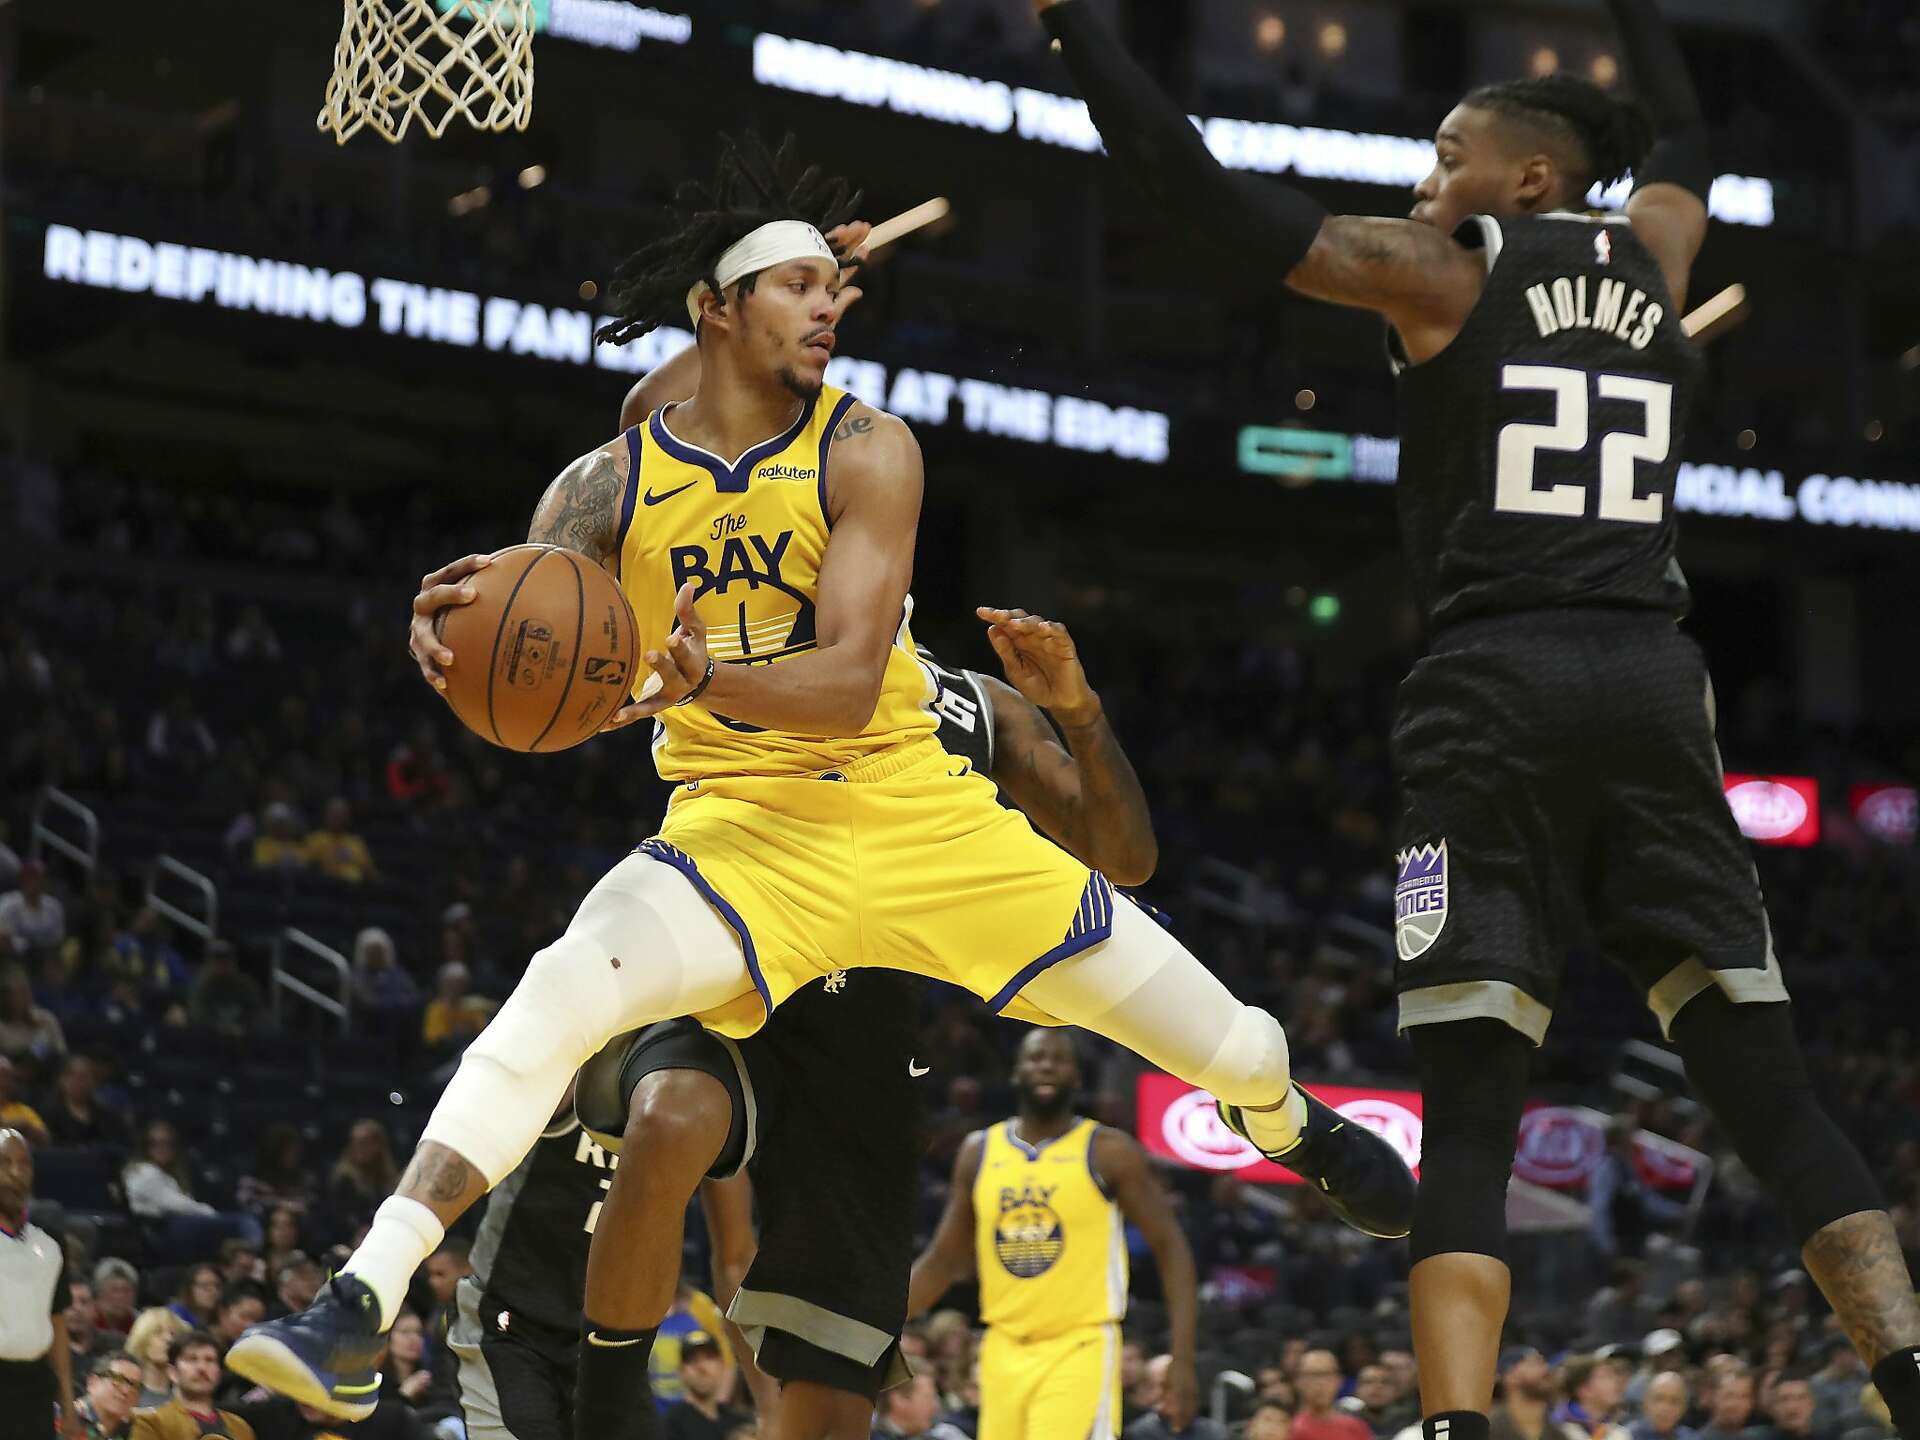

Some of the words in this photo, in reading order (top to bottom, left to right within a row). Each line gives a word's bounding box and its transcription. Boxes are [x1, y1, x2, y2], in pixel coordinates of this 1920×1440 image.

[44, 222, 367, 328] REDEFINING
[370, 276, 480, 348] THE
[482, 295, 592, 365] FAN
[888, 367, 956, 426] AT
[958, 377, 1052, 443] THE
[1054, 394, 1170, 465] EDGE
[1525, 275, 1663, 350] HOLMES
[758, 464, 816, 480] Rakuten
[1494, 364, 1673, 524] 22
[711, 513, 747, 540] The
[670, 530, 793, 600] BAY
